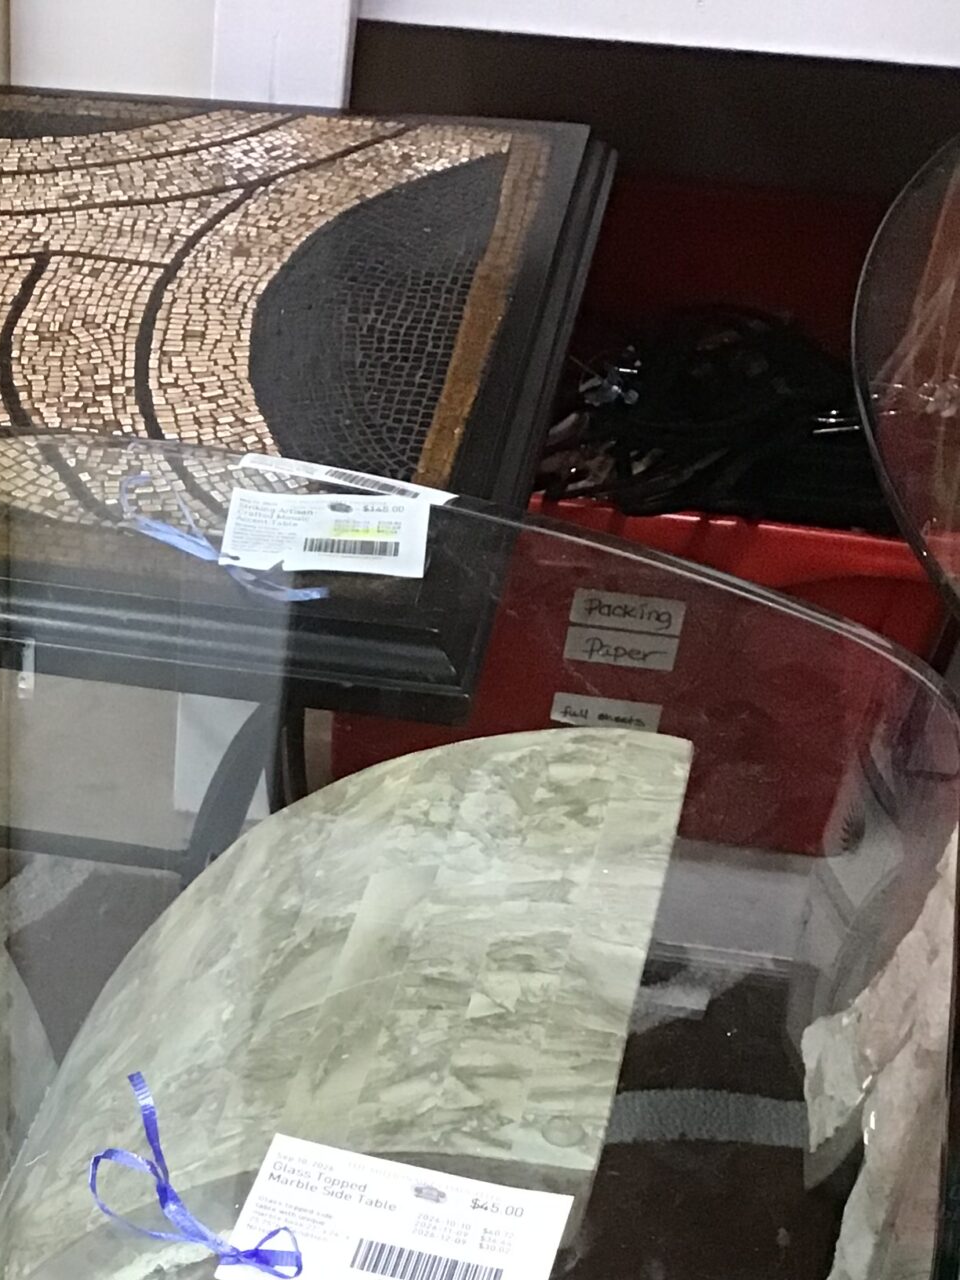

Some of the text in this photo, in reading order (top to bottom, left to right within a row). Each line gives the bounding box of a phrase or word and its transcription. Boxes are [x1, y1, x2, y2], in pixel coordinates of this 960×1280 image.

[584, 599, 672, 631] Packing
[583, 637, 668, 661] Paper
[560, 705, 589, 719] full
[272, 1161, 312, 1179] Glass
[317, 1172, 368, 1194] Topped
[268, 1172, 398, 1212] Marble Side Table
[470, 1198, 524, 1218] $45.00
